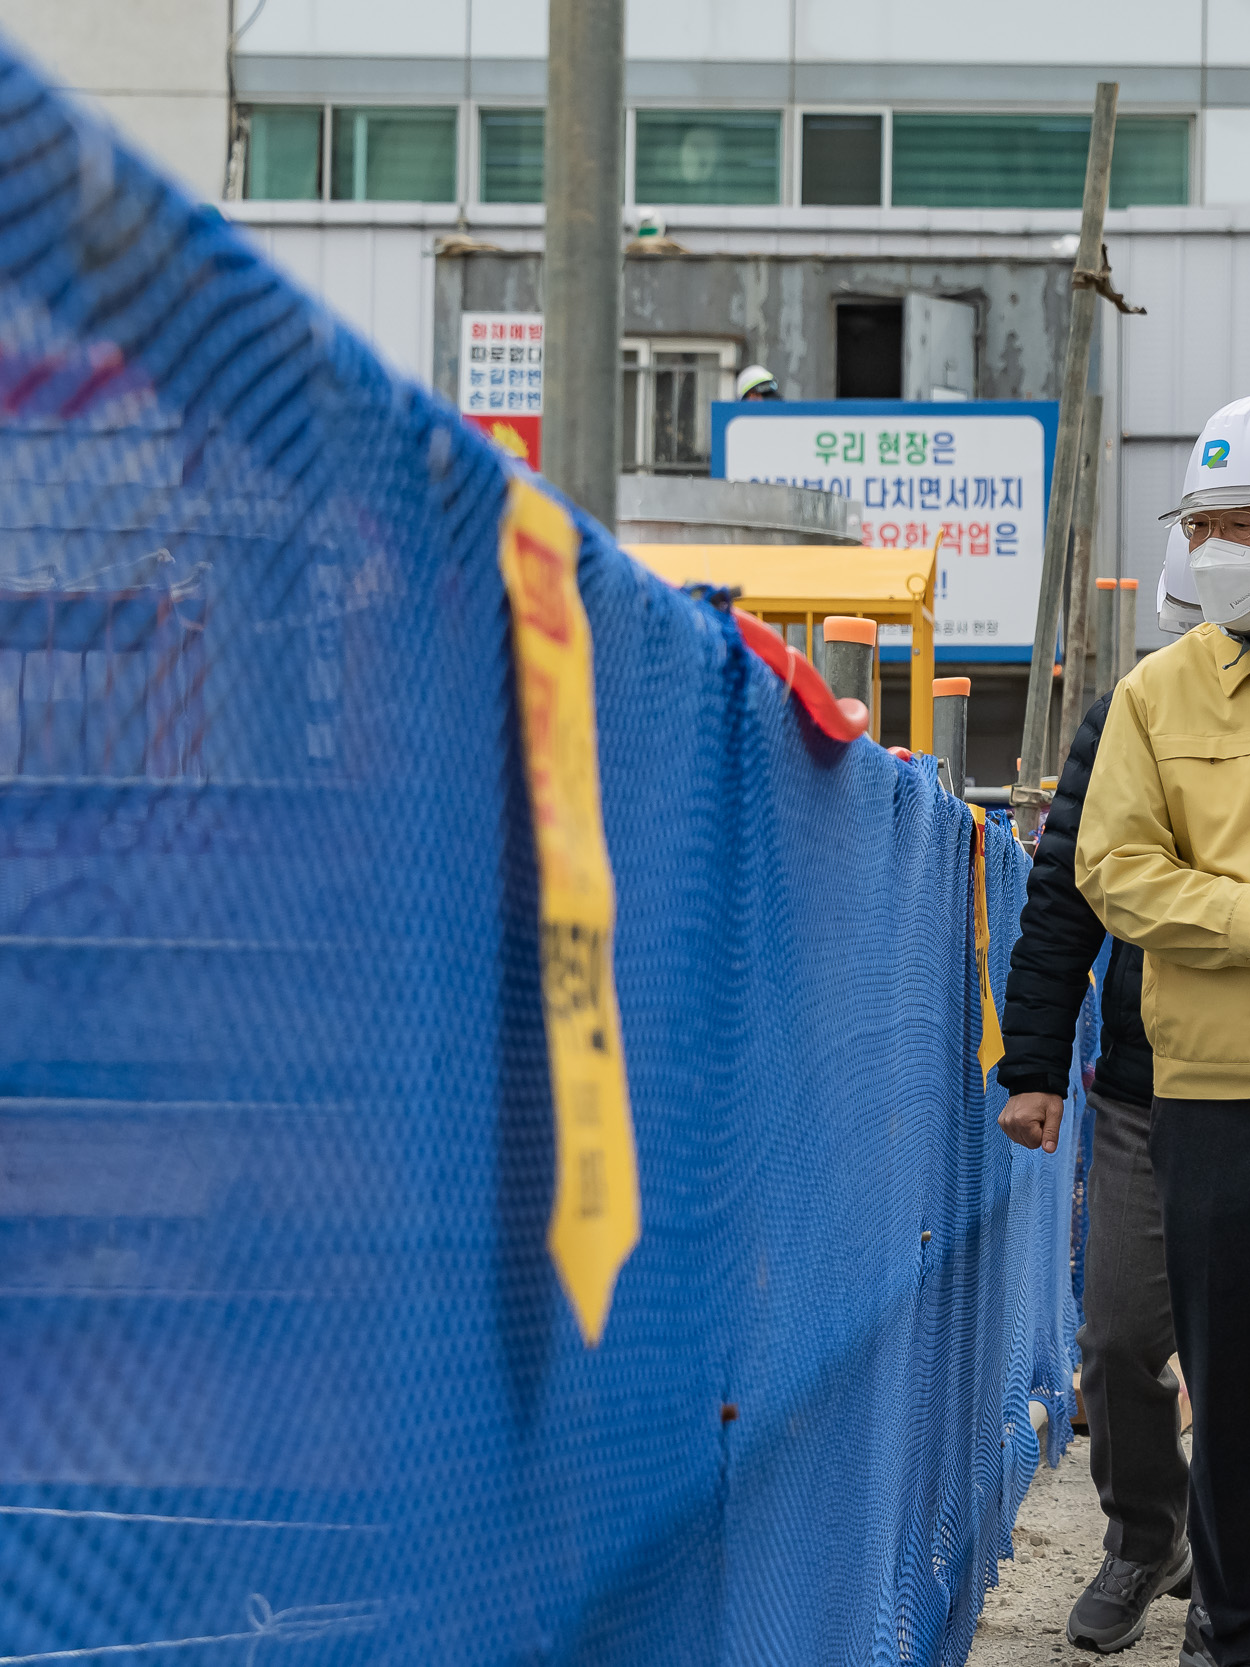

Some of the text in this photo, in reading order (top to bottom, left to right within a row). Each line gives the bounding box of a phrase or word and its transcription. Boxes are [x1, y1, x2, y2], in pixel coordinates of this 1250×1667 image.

[815, 431, 956, 465] 우리 현장은
[864, 476, 1024, 511] 다치면서까지
[940, 521, 1019, 557] 작업은
